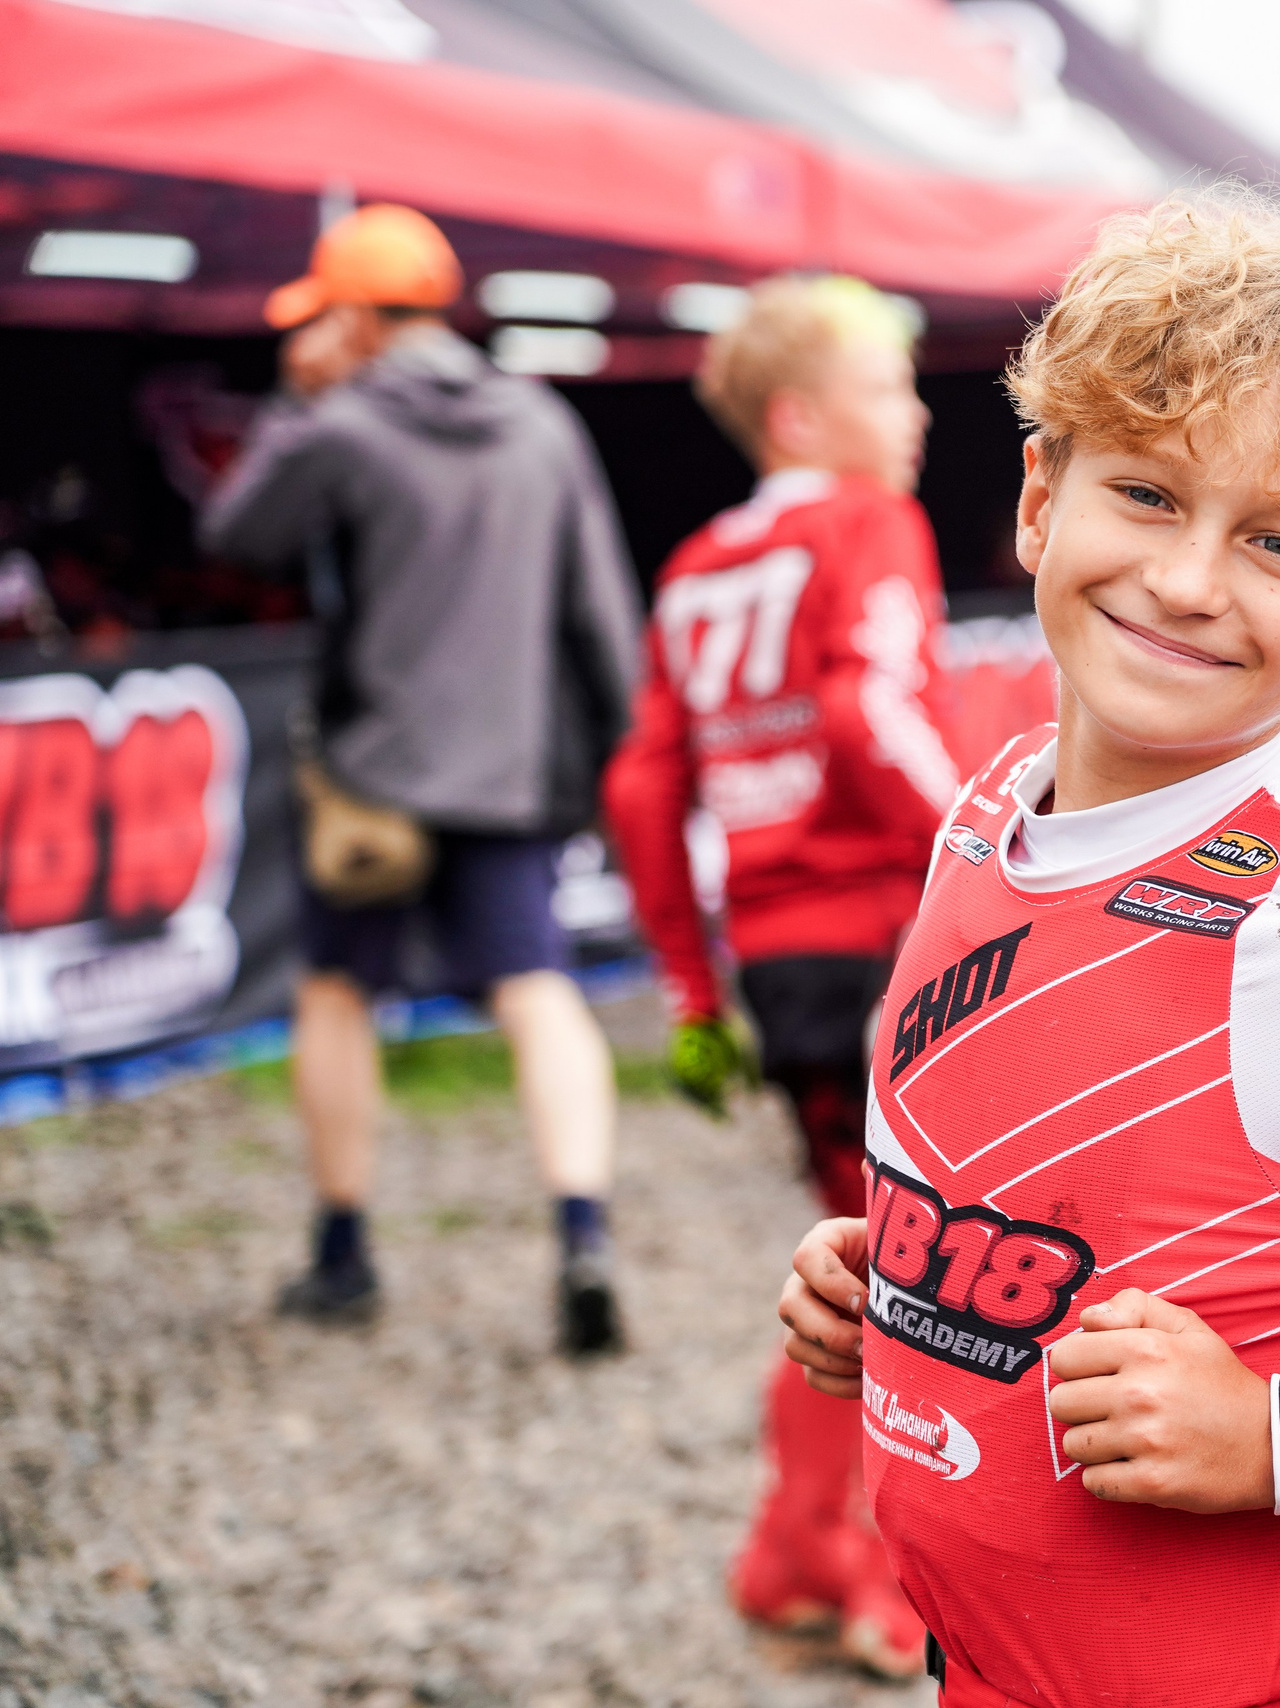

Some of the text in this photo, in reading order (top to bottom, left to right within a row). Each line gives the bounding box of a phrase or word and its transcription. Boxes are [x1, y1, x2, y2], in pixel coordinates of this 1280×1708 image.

[1237, 847, 1271, 867] Air
[1113, 902, 1231, 933] WORKS RACING PARTS
[1119, 881, 1246, 922] WRP
[890, 921, 1033, 1085] SHOT
